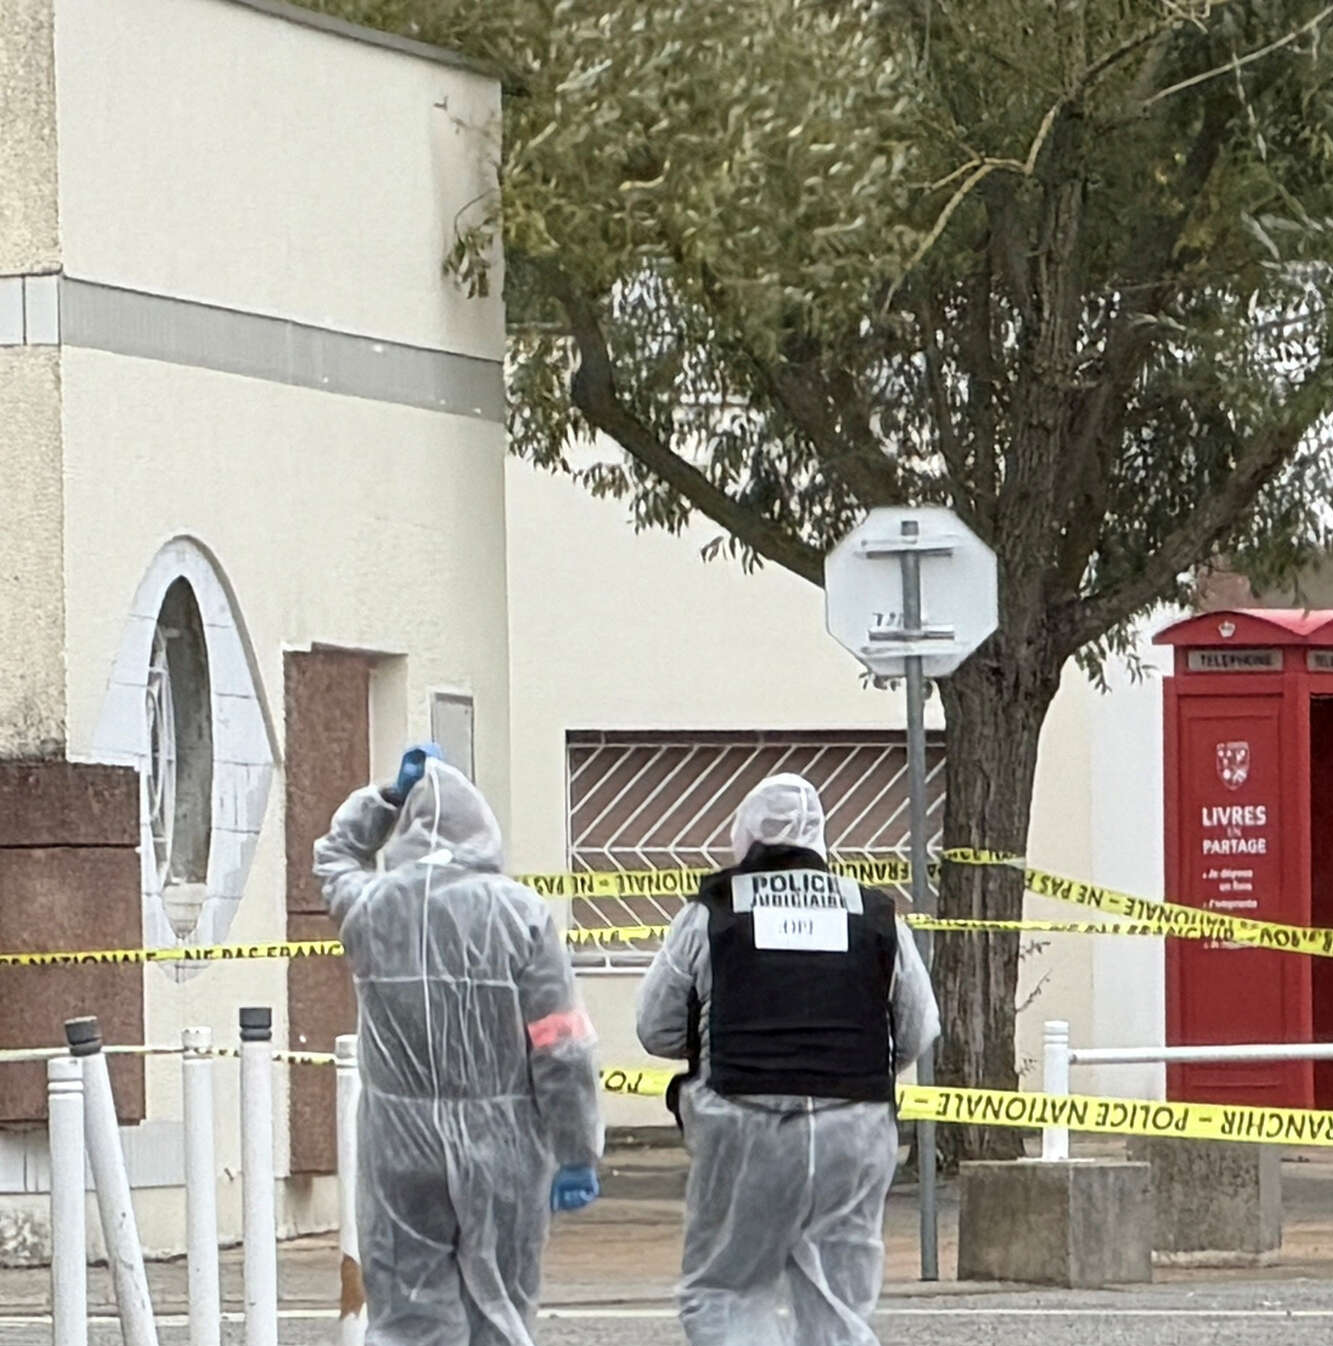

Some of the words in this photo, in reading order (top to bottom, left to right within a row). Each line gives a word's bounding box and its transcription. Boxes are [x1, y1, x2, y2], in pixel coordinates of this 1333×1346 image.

[1202, 806, 1266, 827] LIVRES
[1203, 839, 1266, 855] PARTAGE
[1077, 881, 1101, 906] NE
[935, 1092, 1088, 1126] NATIONALE
[1095, 1103, 1189, 1131] POLICE
